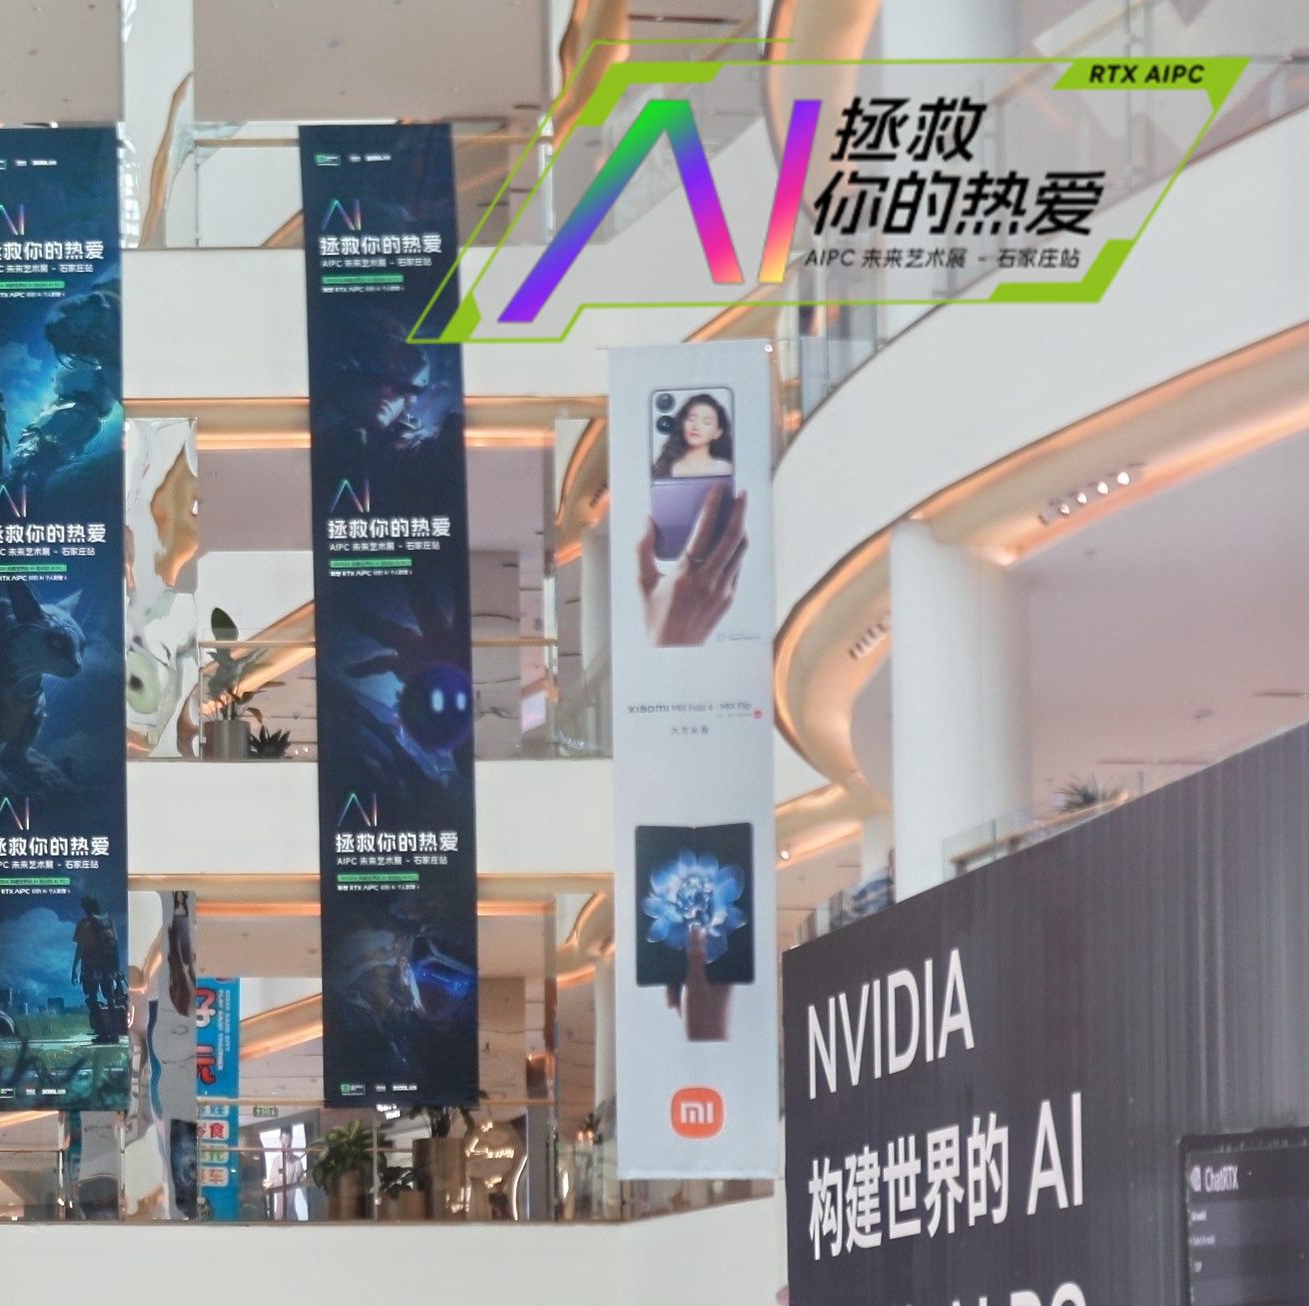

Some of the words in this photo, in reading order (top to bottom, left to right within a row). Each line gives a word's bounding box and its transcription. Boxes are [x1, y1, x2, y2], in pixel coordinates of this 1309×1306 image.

[319, 235, 442, 256] 拯救你的热爱
[328, 518, 451, 539] 拯救你的热爱
[335, 832, 459, 854] 拯救你的热爱
[808, 948, 975, 1100] NVIDIA
[808, 1112, 1009, 1261] 构建世界的
[1027, 1091, 1084, 1216] AI
